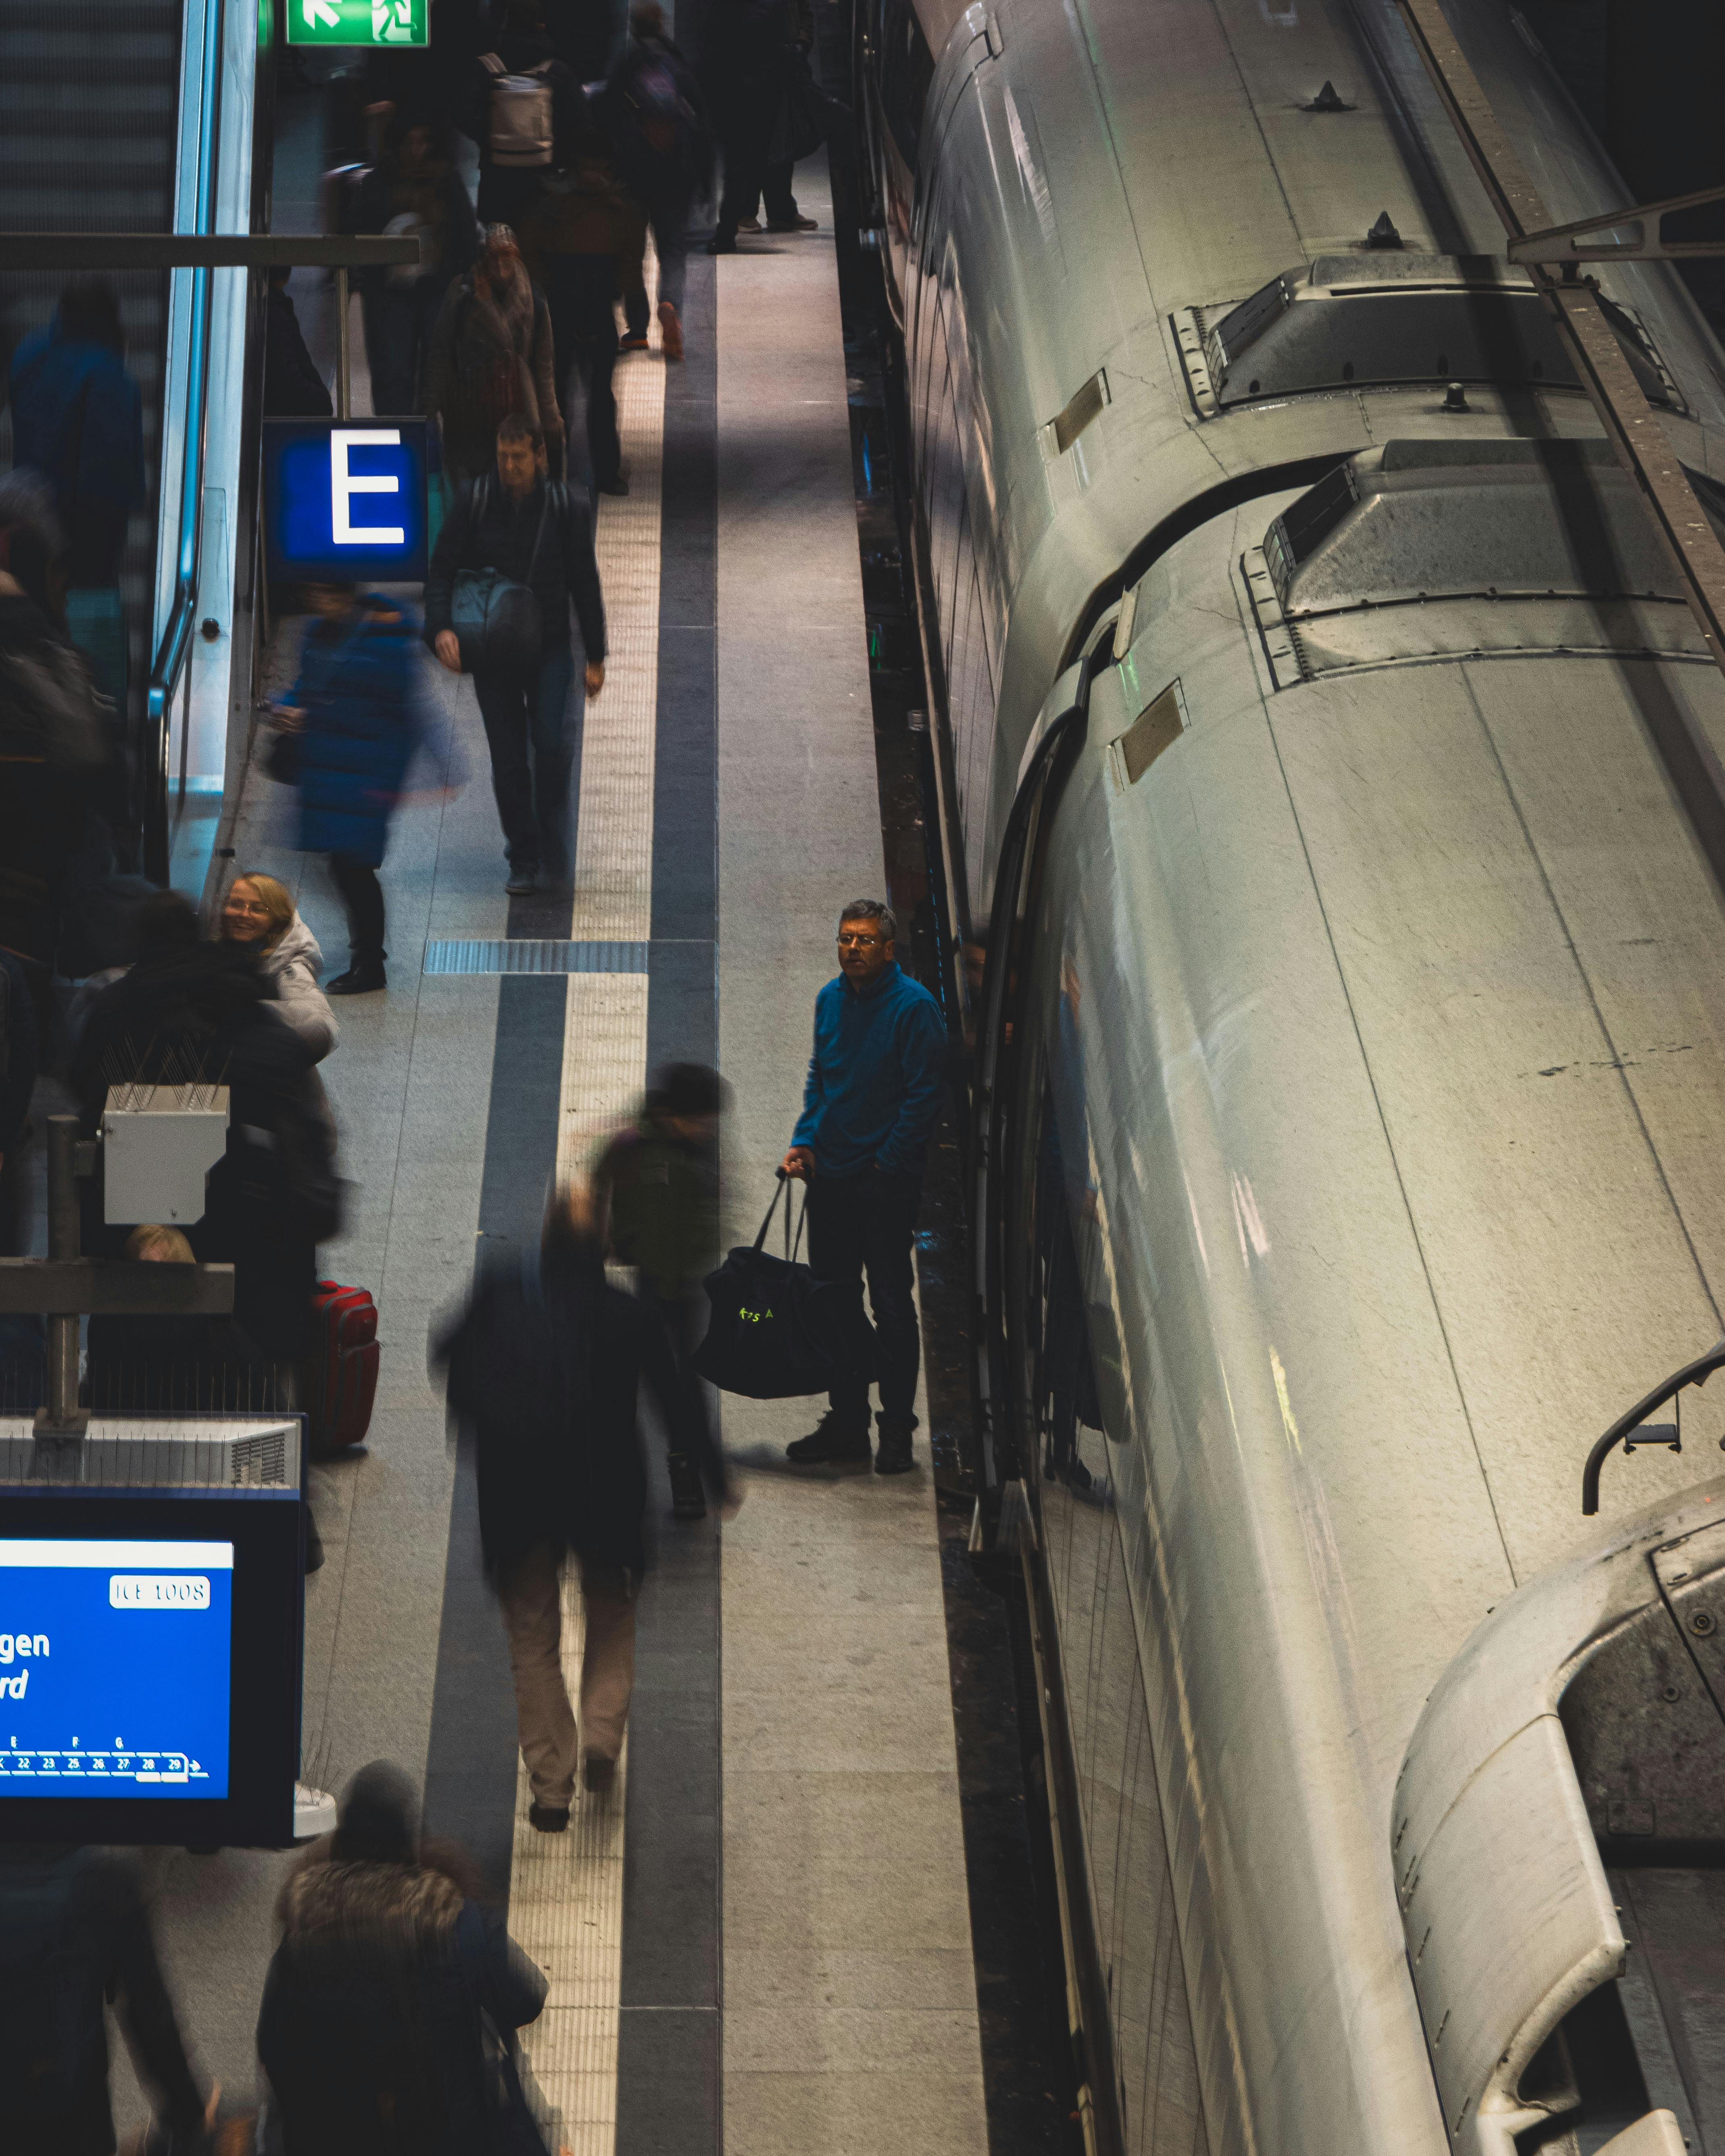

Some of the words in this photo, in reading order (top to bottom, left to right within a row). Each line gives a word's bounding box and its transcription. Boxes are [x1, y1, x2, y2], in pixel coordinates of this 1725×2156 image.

[331, 429, 405, 544] E
[117, 1583, 144, 1600] ICE
[154, 1583, 204, 1601] 1008
[72, 1736, 80, 1749] F
[18, 1758, 30, 1770] 22
[43, 1758, 55, 1770] 23
[68, 1758, 80, 1770] 25
[93, 1758, 106, 1770] 26
[117, 1758, 130, 1770] 27
[142, 1759, 155, 1771] 28
[168, 1759, 181, 1771] 29
